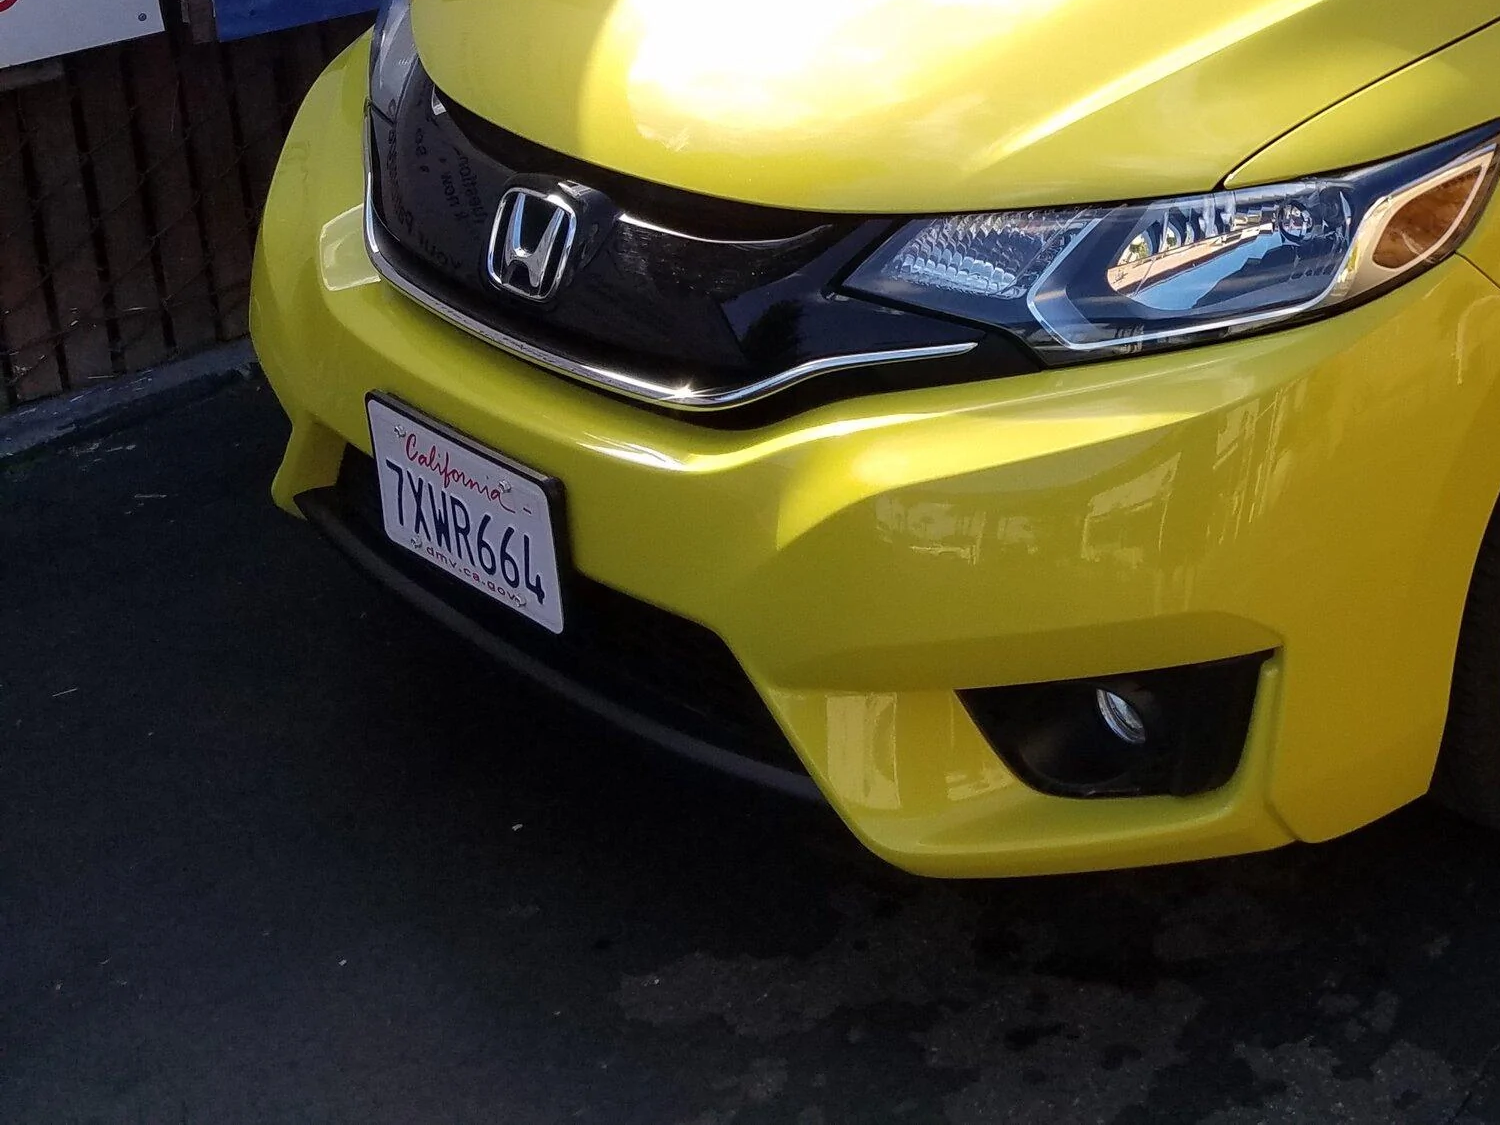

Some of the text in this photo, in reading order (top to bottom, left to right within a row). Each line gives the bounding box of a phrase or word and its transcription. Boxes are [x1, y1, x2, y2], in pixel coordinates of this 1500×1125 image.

[405, 433, 516, 514] California
[386, 459, 545, 605] 7XWR664
[427, 546, 519, 604] dmv.ca.gov
